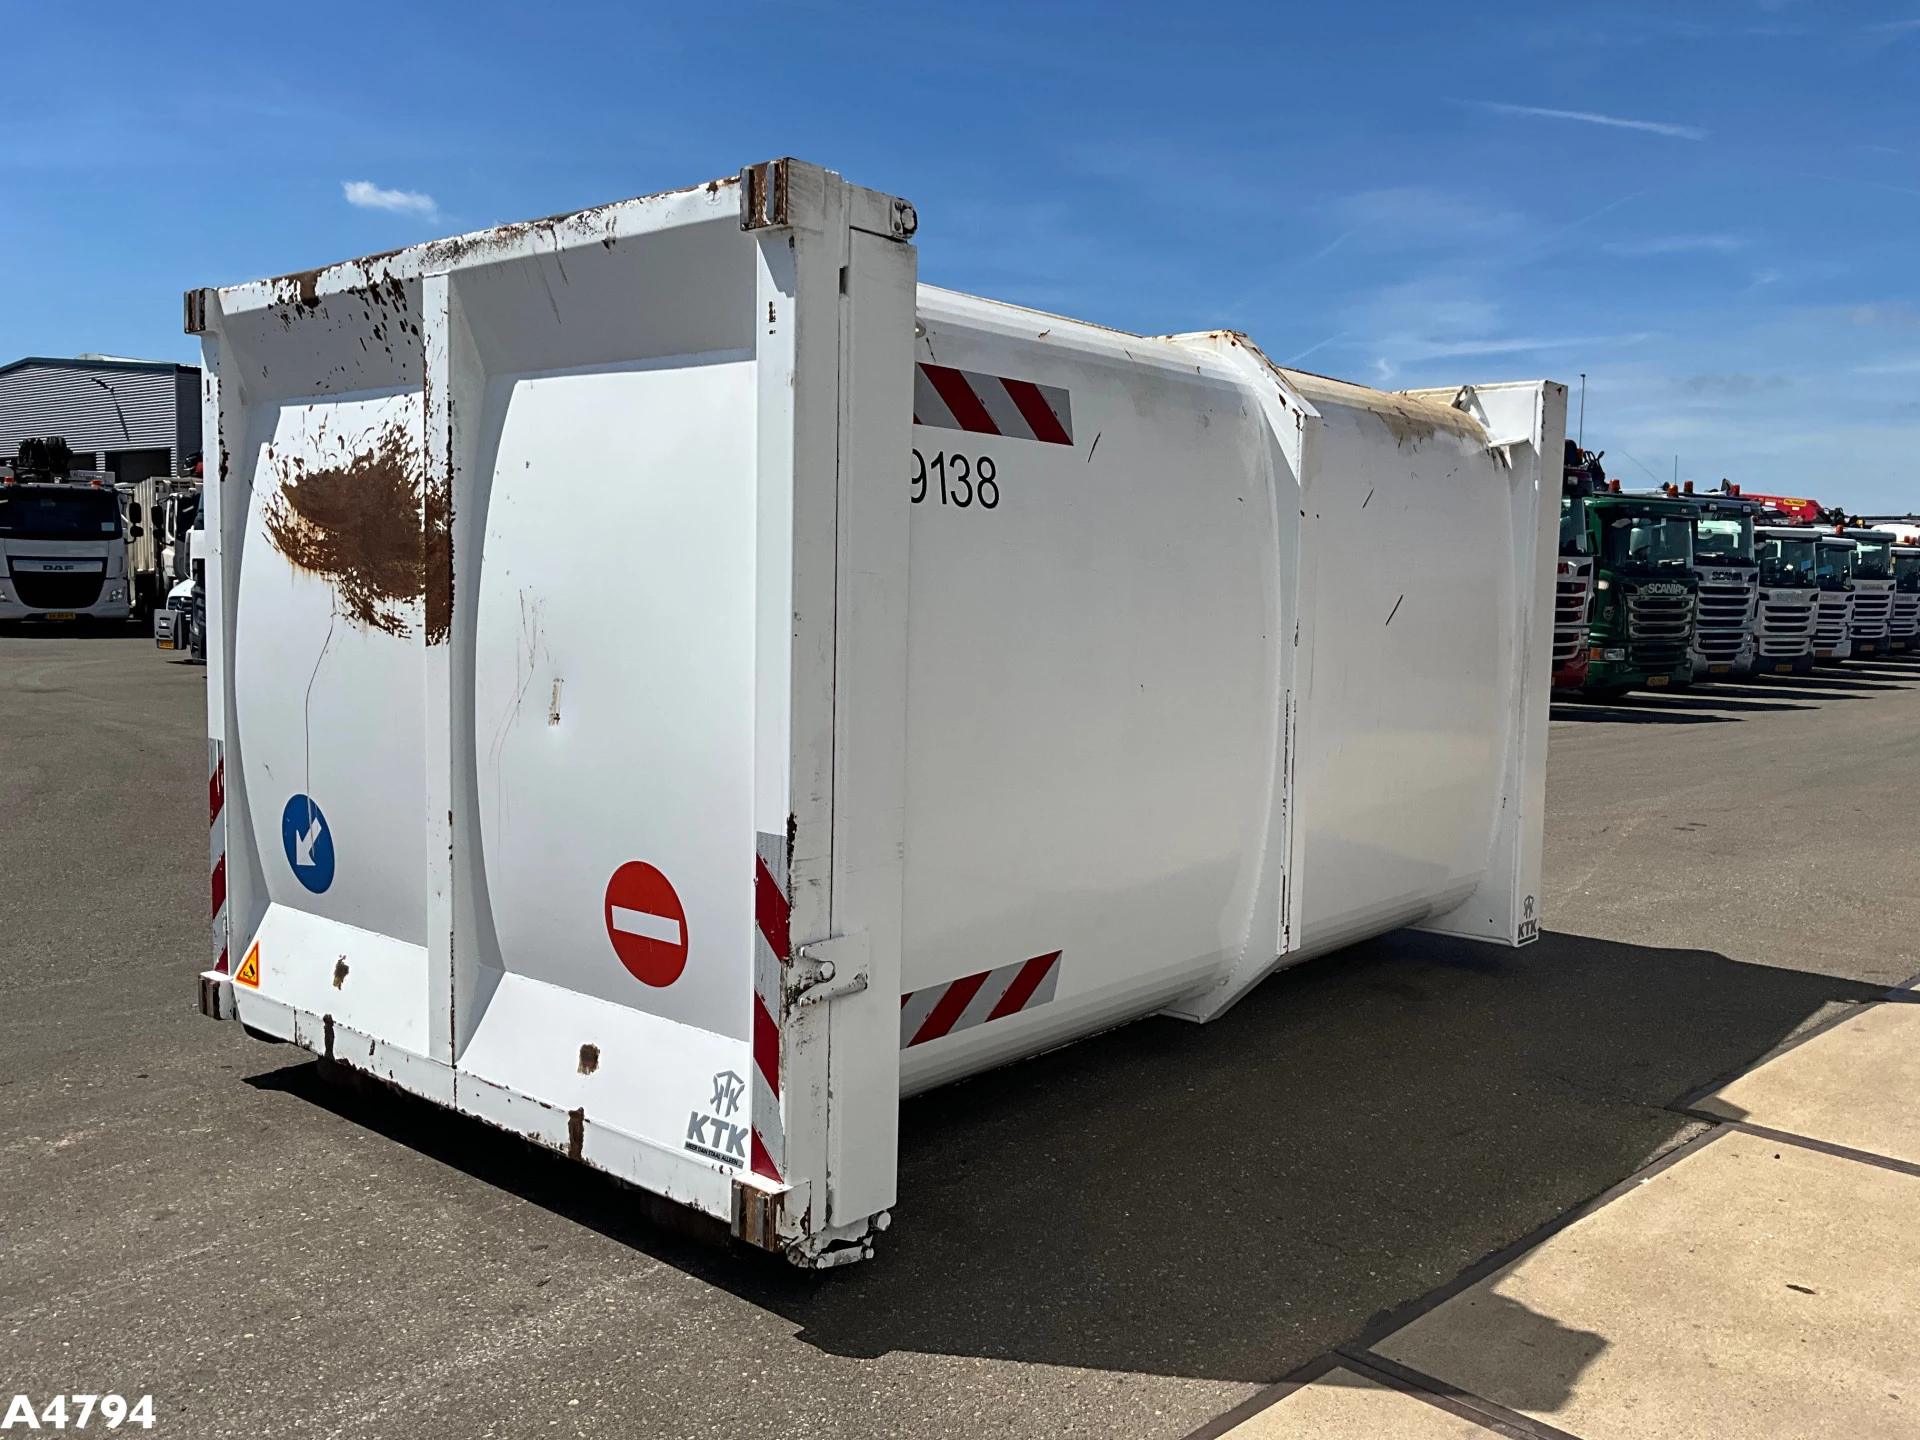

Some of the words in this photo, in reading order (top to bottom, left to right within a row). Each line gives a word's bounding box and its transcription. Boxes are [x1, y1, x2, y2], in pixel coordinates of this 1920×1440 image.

[911, 448, 999, 509] 9138
[1712, 571, 1742, 581] SCANIA
[1648, 583, 1681, 594] SCANIA
[1518, 918, 1537, 939] KTK
[686, 1110, 749, 1158] KTK
[685, 1142, 698, 1151] MEER
[708, 1149, 721, 1159] STAAL
[721, 1155, 738, 1165] ALLEEN
